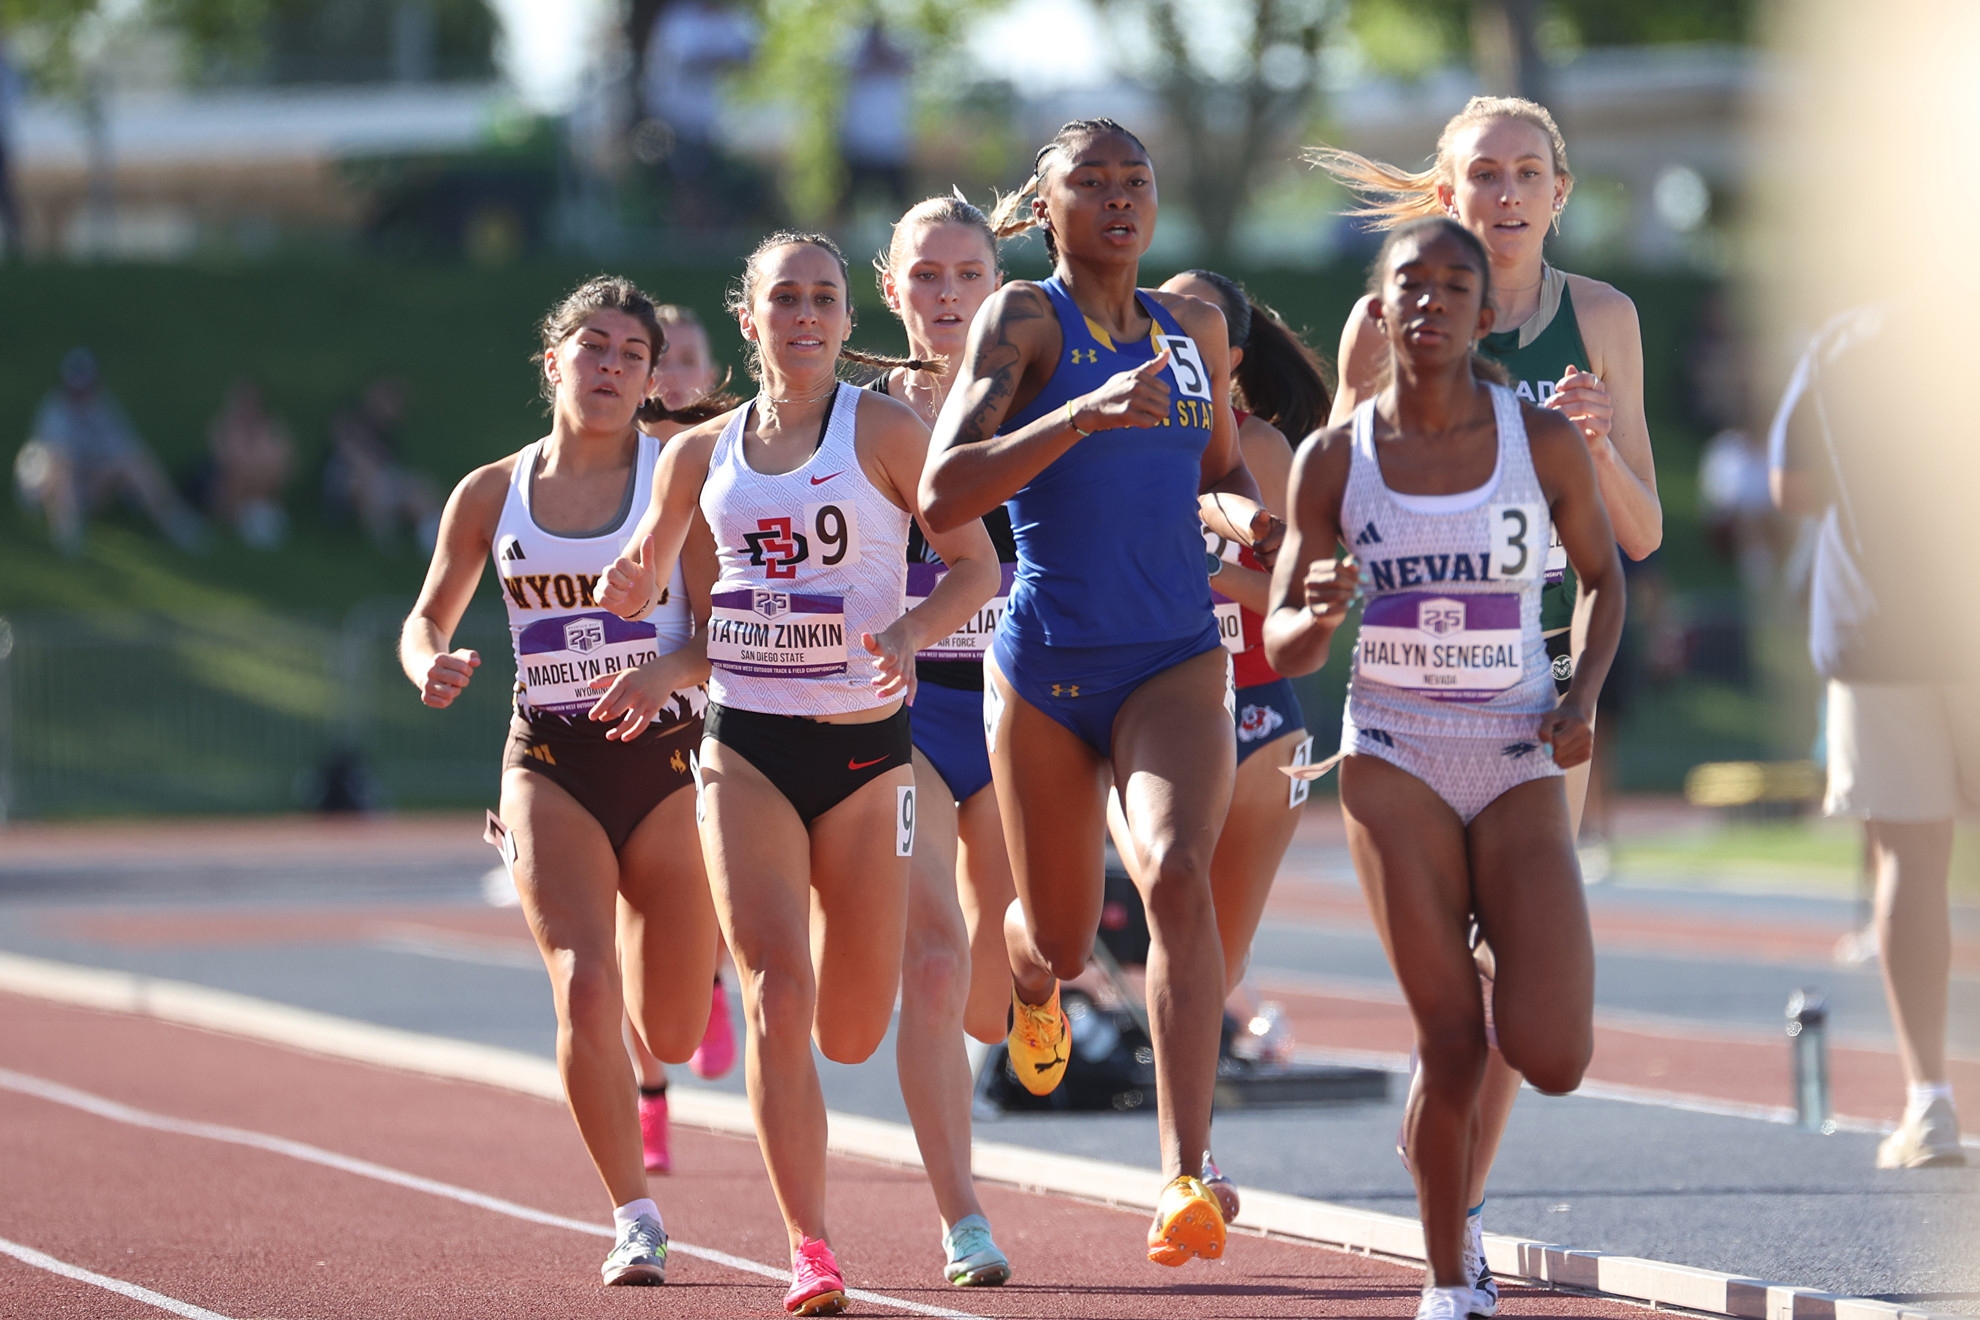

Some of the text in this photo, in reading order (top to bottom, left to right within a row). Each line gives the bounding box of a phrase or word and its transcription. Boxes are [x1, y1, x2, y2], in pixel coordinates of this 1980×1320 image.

[1167, 339, 1202, 393] 5
[815, 504, 849, 566] 9
[1501, 508, 1528, 576] 3
[568, 626, 602, 646] 25
[711, 618, 843, 649] TATUM ZINKIN
[952, 637, 976, 648] FORCE
[740, 649, 805, 663] SAN DIEGO STATE
[1363, 641, 1519, 668] HALYN SENEGAL
[527, 658, 601, 688] MADELYN
[902, 789, 914, 854] 9
